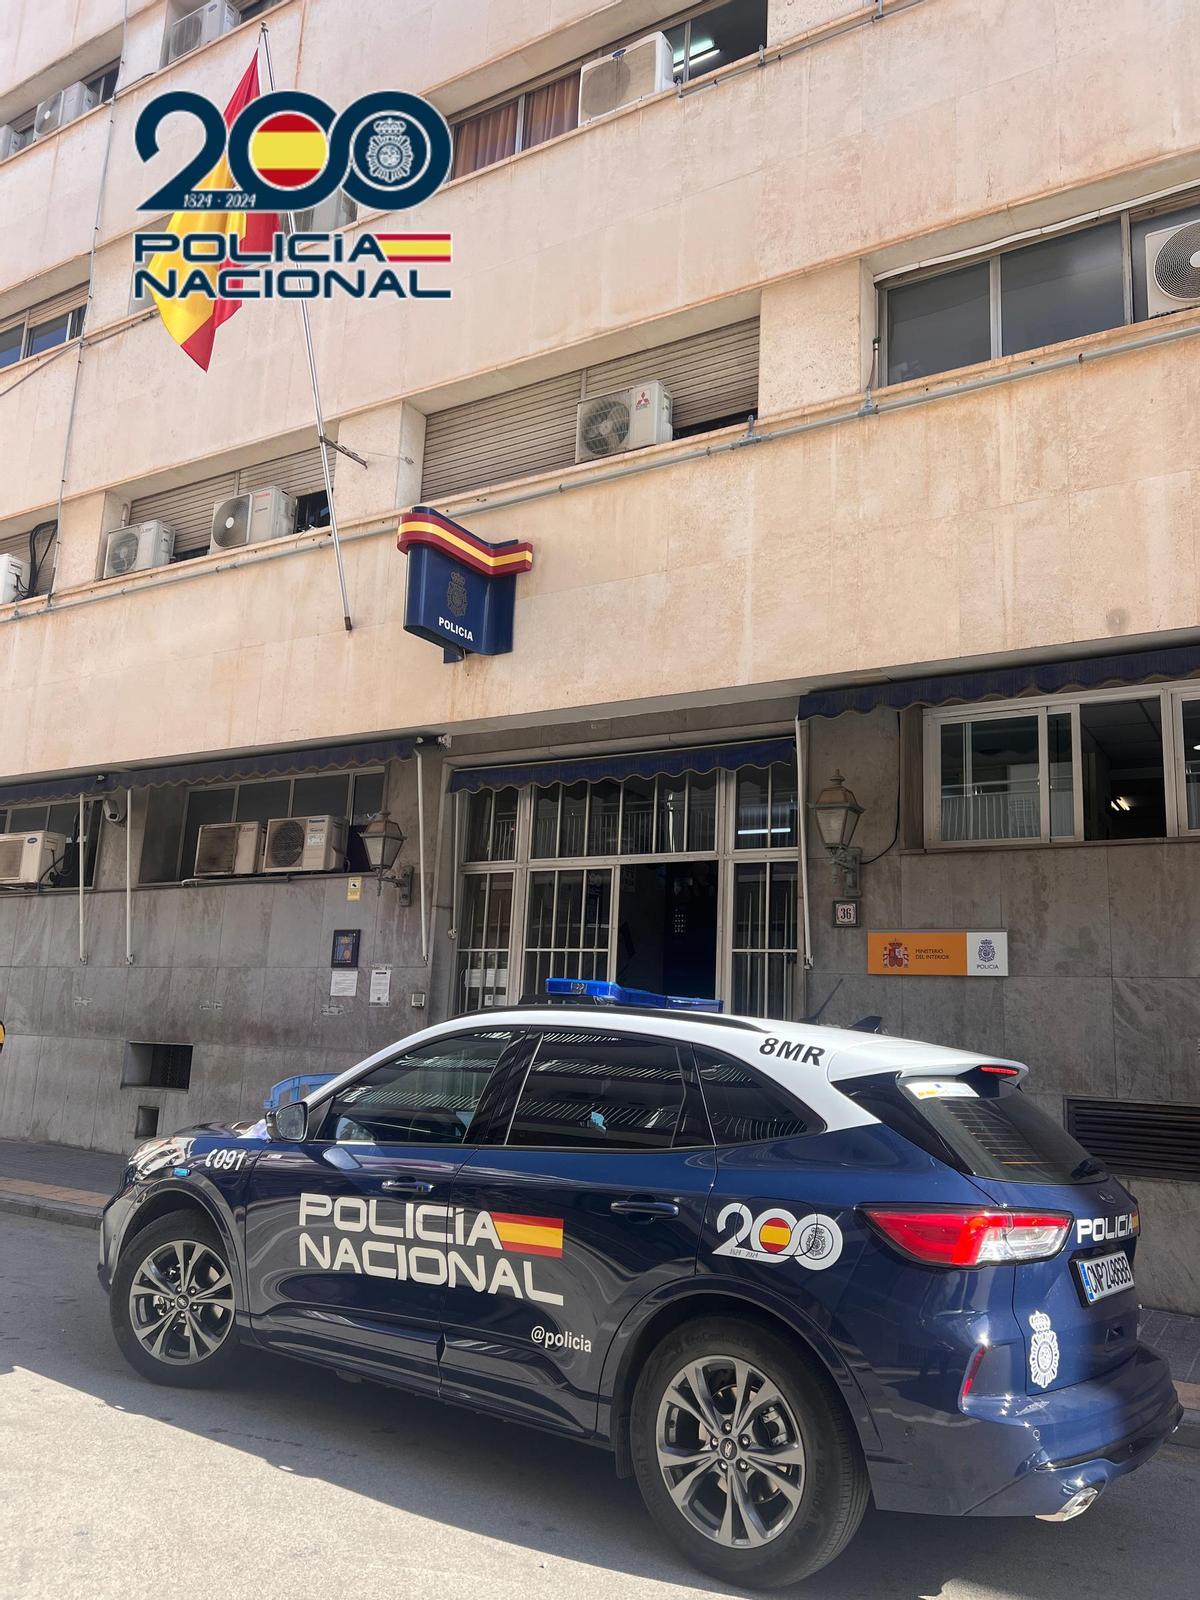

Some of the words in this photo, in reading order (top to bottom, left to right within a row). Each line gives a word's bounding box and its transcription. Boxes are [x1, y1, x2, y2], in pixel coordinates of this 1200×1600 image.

[438, 616, 474, 641] POLICIA
[840, 907, 852, 920] 36
[759, 1037, 826, 1067] 8MR
[299, 1233, 564, 1306] NACIONAL
[530, 1325, 592, 1353] @policia
